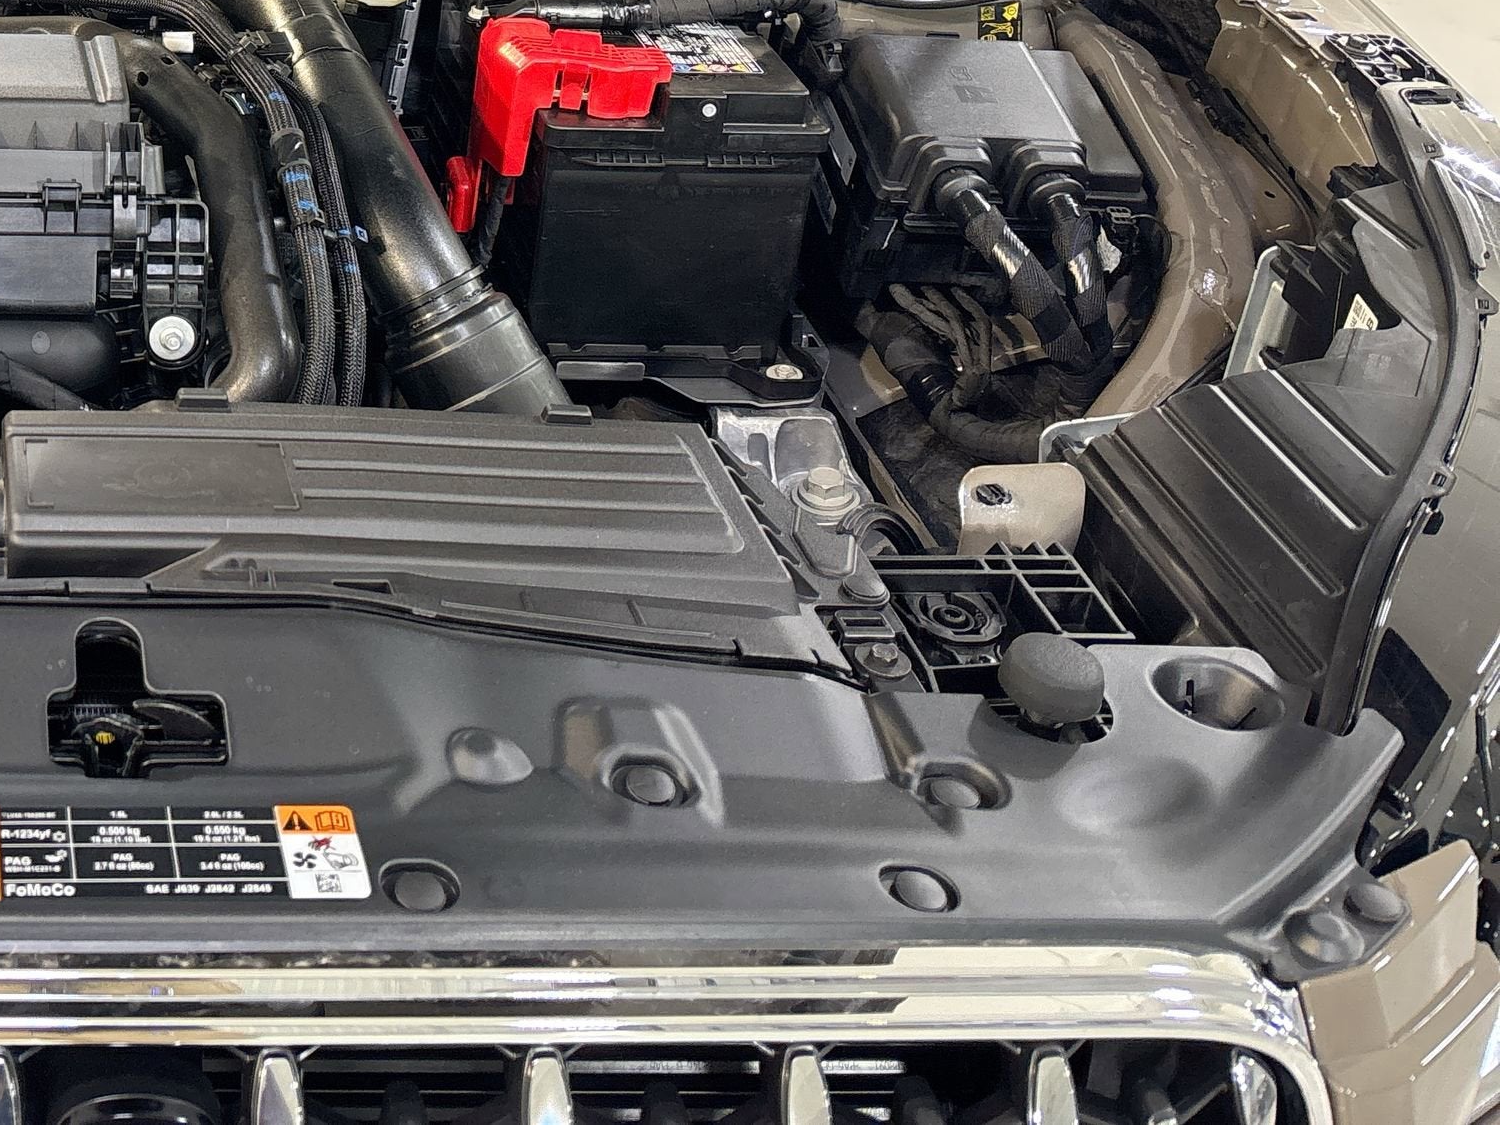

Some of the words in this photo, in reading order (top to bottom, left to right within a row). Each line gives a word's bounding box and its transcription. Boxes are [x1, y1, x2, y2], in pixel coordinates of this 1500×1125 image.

[1, 828, 51, 840] R-1234yf
[127, 826, 141, 839] kg
[232, 825, 246, 838] kg
[4, 856, 32, 866] PAG
[112, 853, 134, 862] PAG
[219, 853, 242, 862] PAG
[5, 882, 77, 897] FoMoCo
[146, 884, 169, 894] SAE
[175, 884, 200, 894] J639
